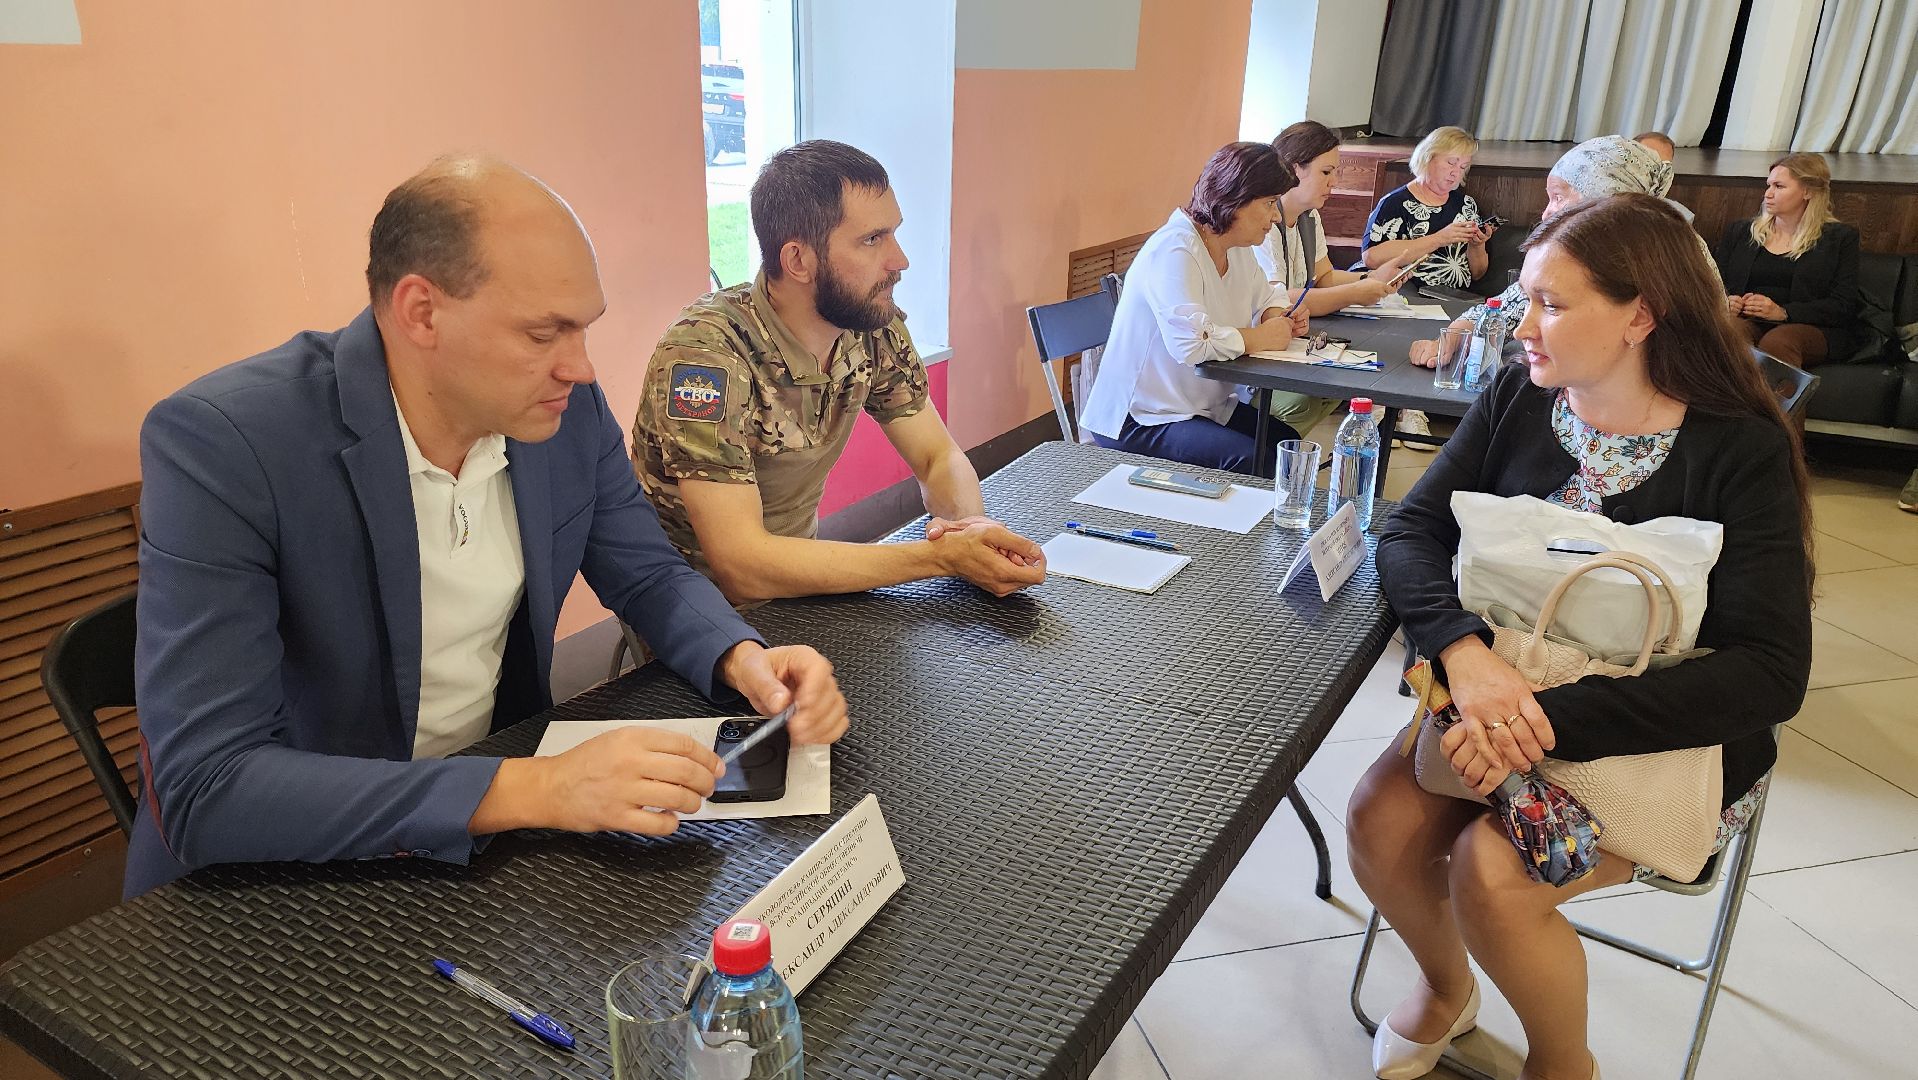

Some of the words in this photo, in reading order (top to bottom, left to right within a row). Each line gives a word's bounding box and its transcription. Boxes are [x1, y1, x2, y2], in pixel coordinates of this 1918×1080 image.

[680, 389, 714, 404] СВО
[757, 880, 801, 922] УКОВОДИТЕЛЬ
[781, 931, 827, 981] ЕКСАНДР
[827, 861, 892, 937] АЛЕКСАНДРОВИЧ
